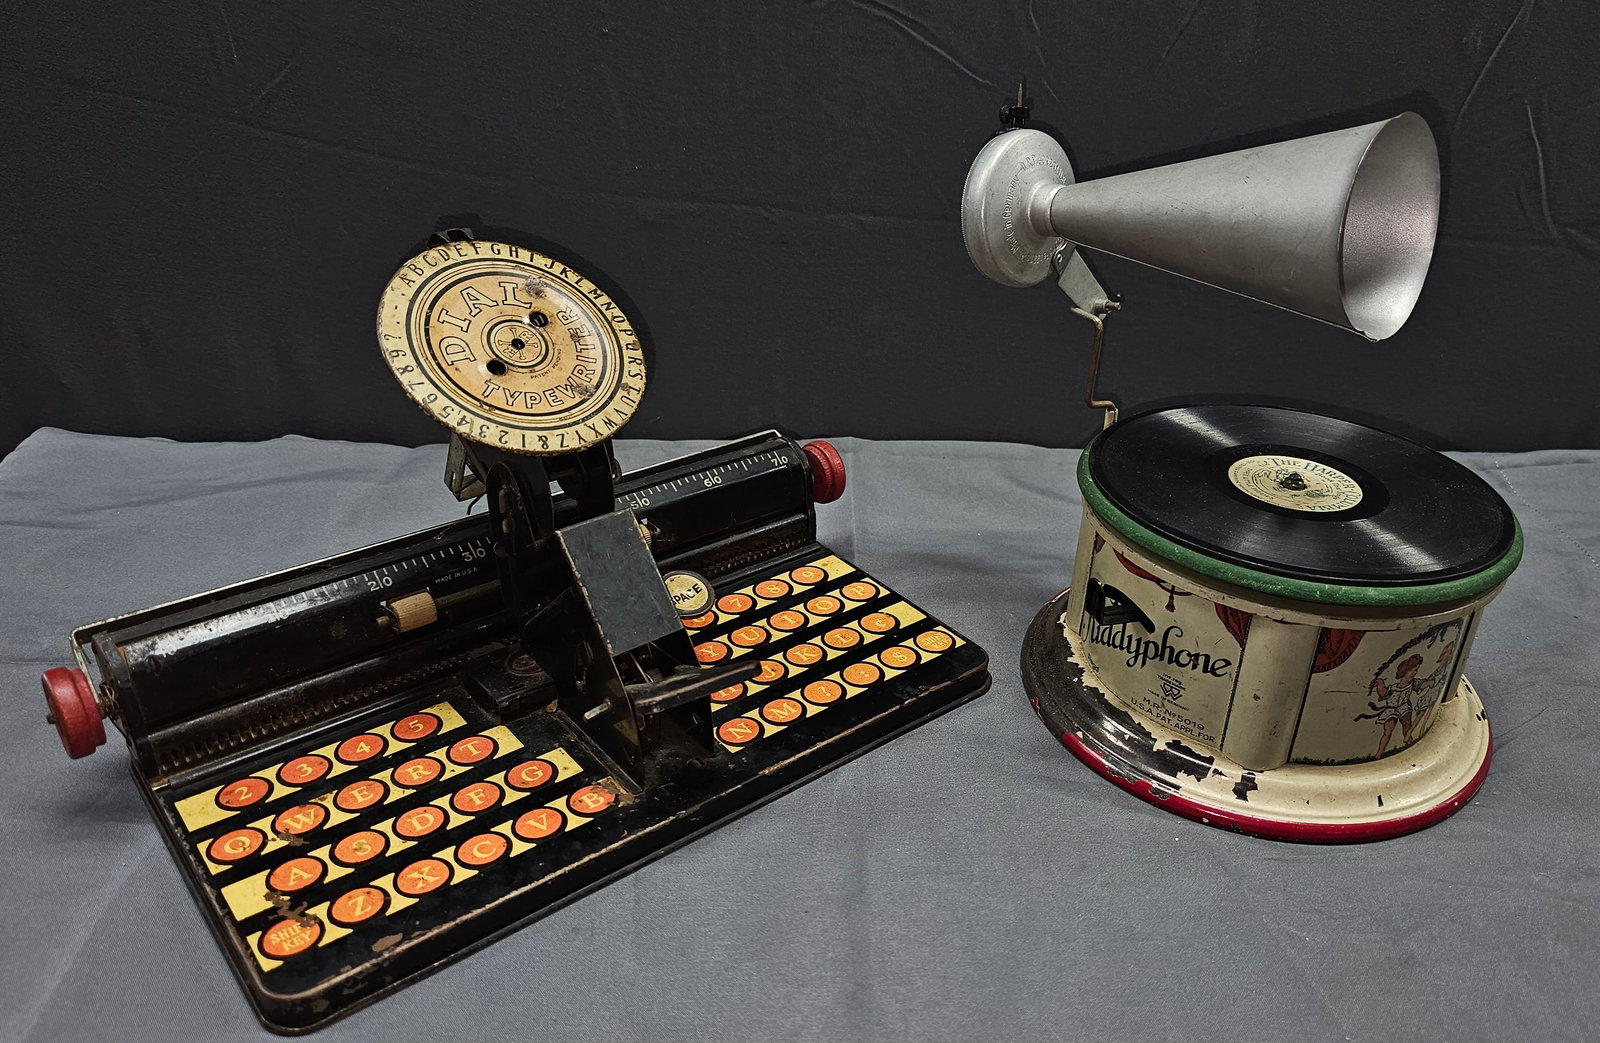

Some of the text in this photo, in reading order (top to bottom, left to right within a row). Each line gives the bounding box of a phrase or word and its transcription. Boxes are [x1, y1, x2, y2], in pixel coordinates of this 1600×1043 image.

[439, 281, 532, 366] DIAL
[481, 305, 598, 409] TYPEWRITER
[530, 369, 552, 379] PATENT
[435, 574, 452, 583] MADE
[1176, 715, 1205, 730] 5019
[282, 930, 312, 952] KEY
